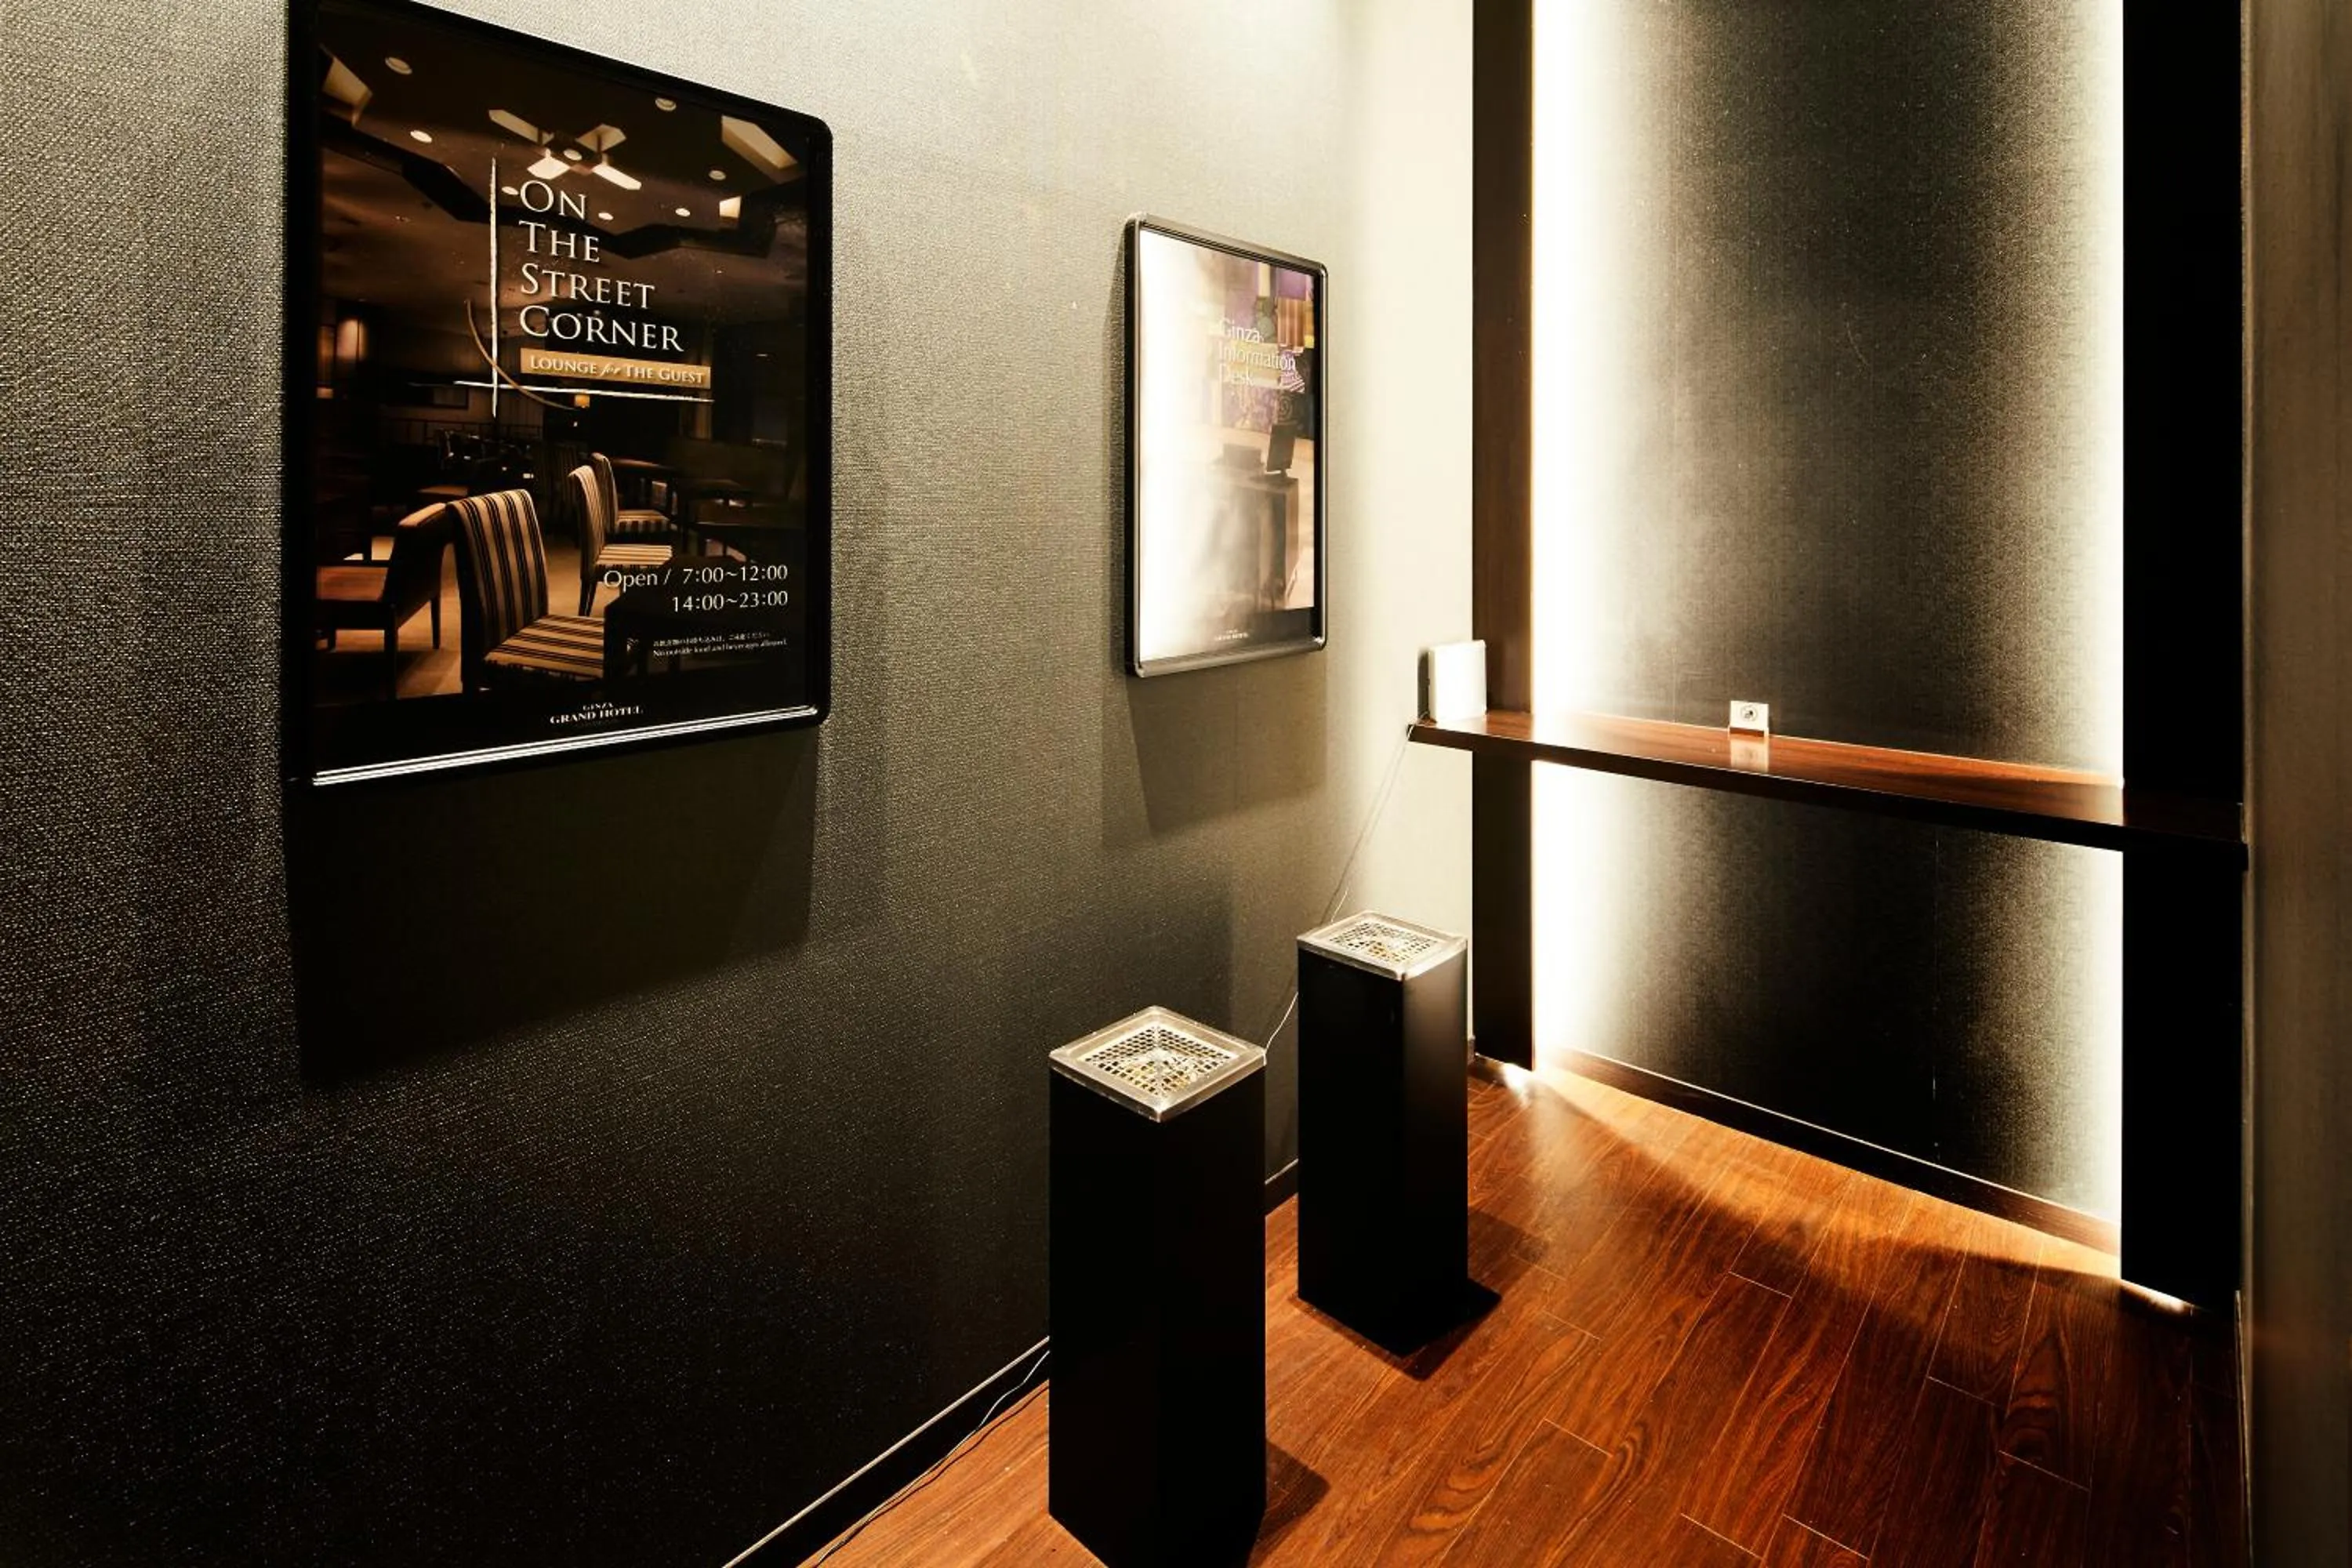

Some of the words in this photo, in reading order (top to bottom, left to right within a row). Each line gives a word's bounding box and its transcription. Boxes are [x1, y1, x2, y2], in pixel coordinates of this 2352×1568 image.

[520, 180, 586, 220] ON
[519, 220, 600, 263] THE
[521, 263, 655, 309] STREET
[519, 304, 684, 352] CORNER
[1219, 318, 1260, 343] Ginza
[530, 355, 597, 374] LOUNGE
[600, 361, 620, 377] for
[625, 363, 653, 379] THE
[659, 367, 704, 383] GUEST
[1218, 339, 1296, 371] Information
[1220, 364, 1254, 386] Desk
[604, 569, 658, 592] Open
[550, 711, 596, 724] GRAND
[600, 706, 641, 719] HOTEL
